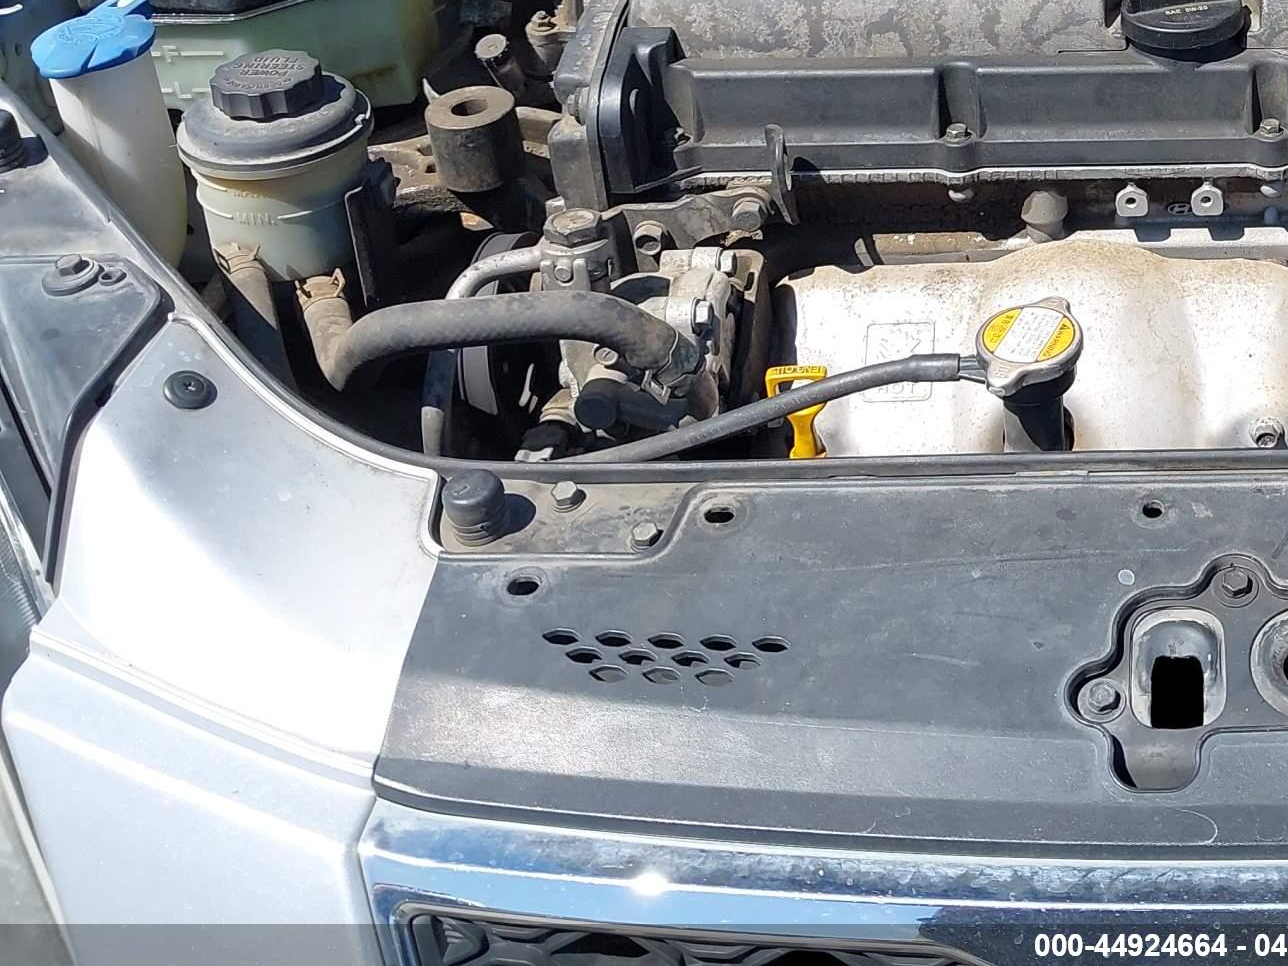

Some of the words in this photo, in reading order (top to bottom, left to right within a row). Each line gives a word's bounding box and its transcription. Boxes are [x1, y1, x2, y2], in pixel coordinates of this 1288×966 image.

[254, 56, 299, 64] FLUID
[233, 63, 306, 71] STEERING
[239, 69, 288, 77] POWER
